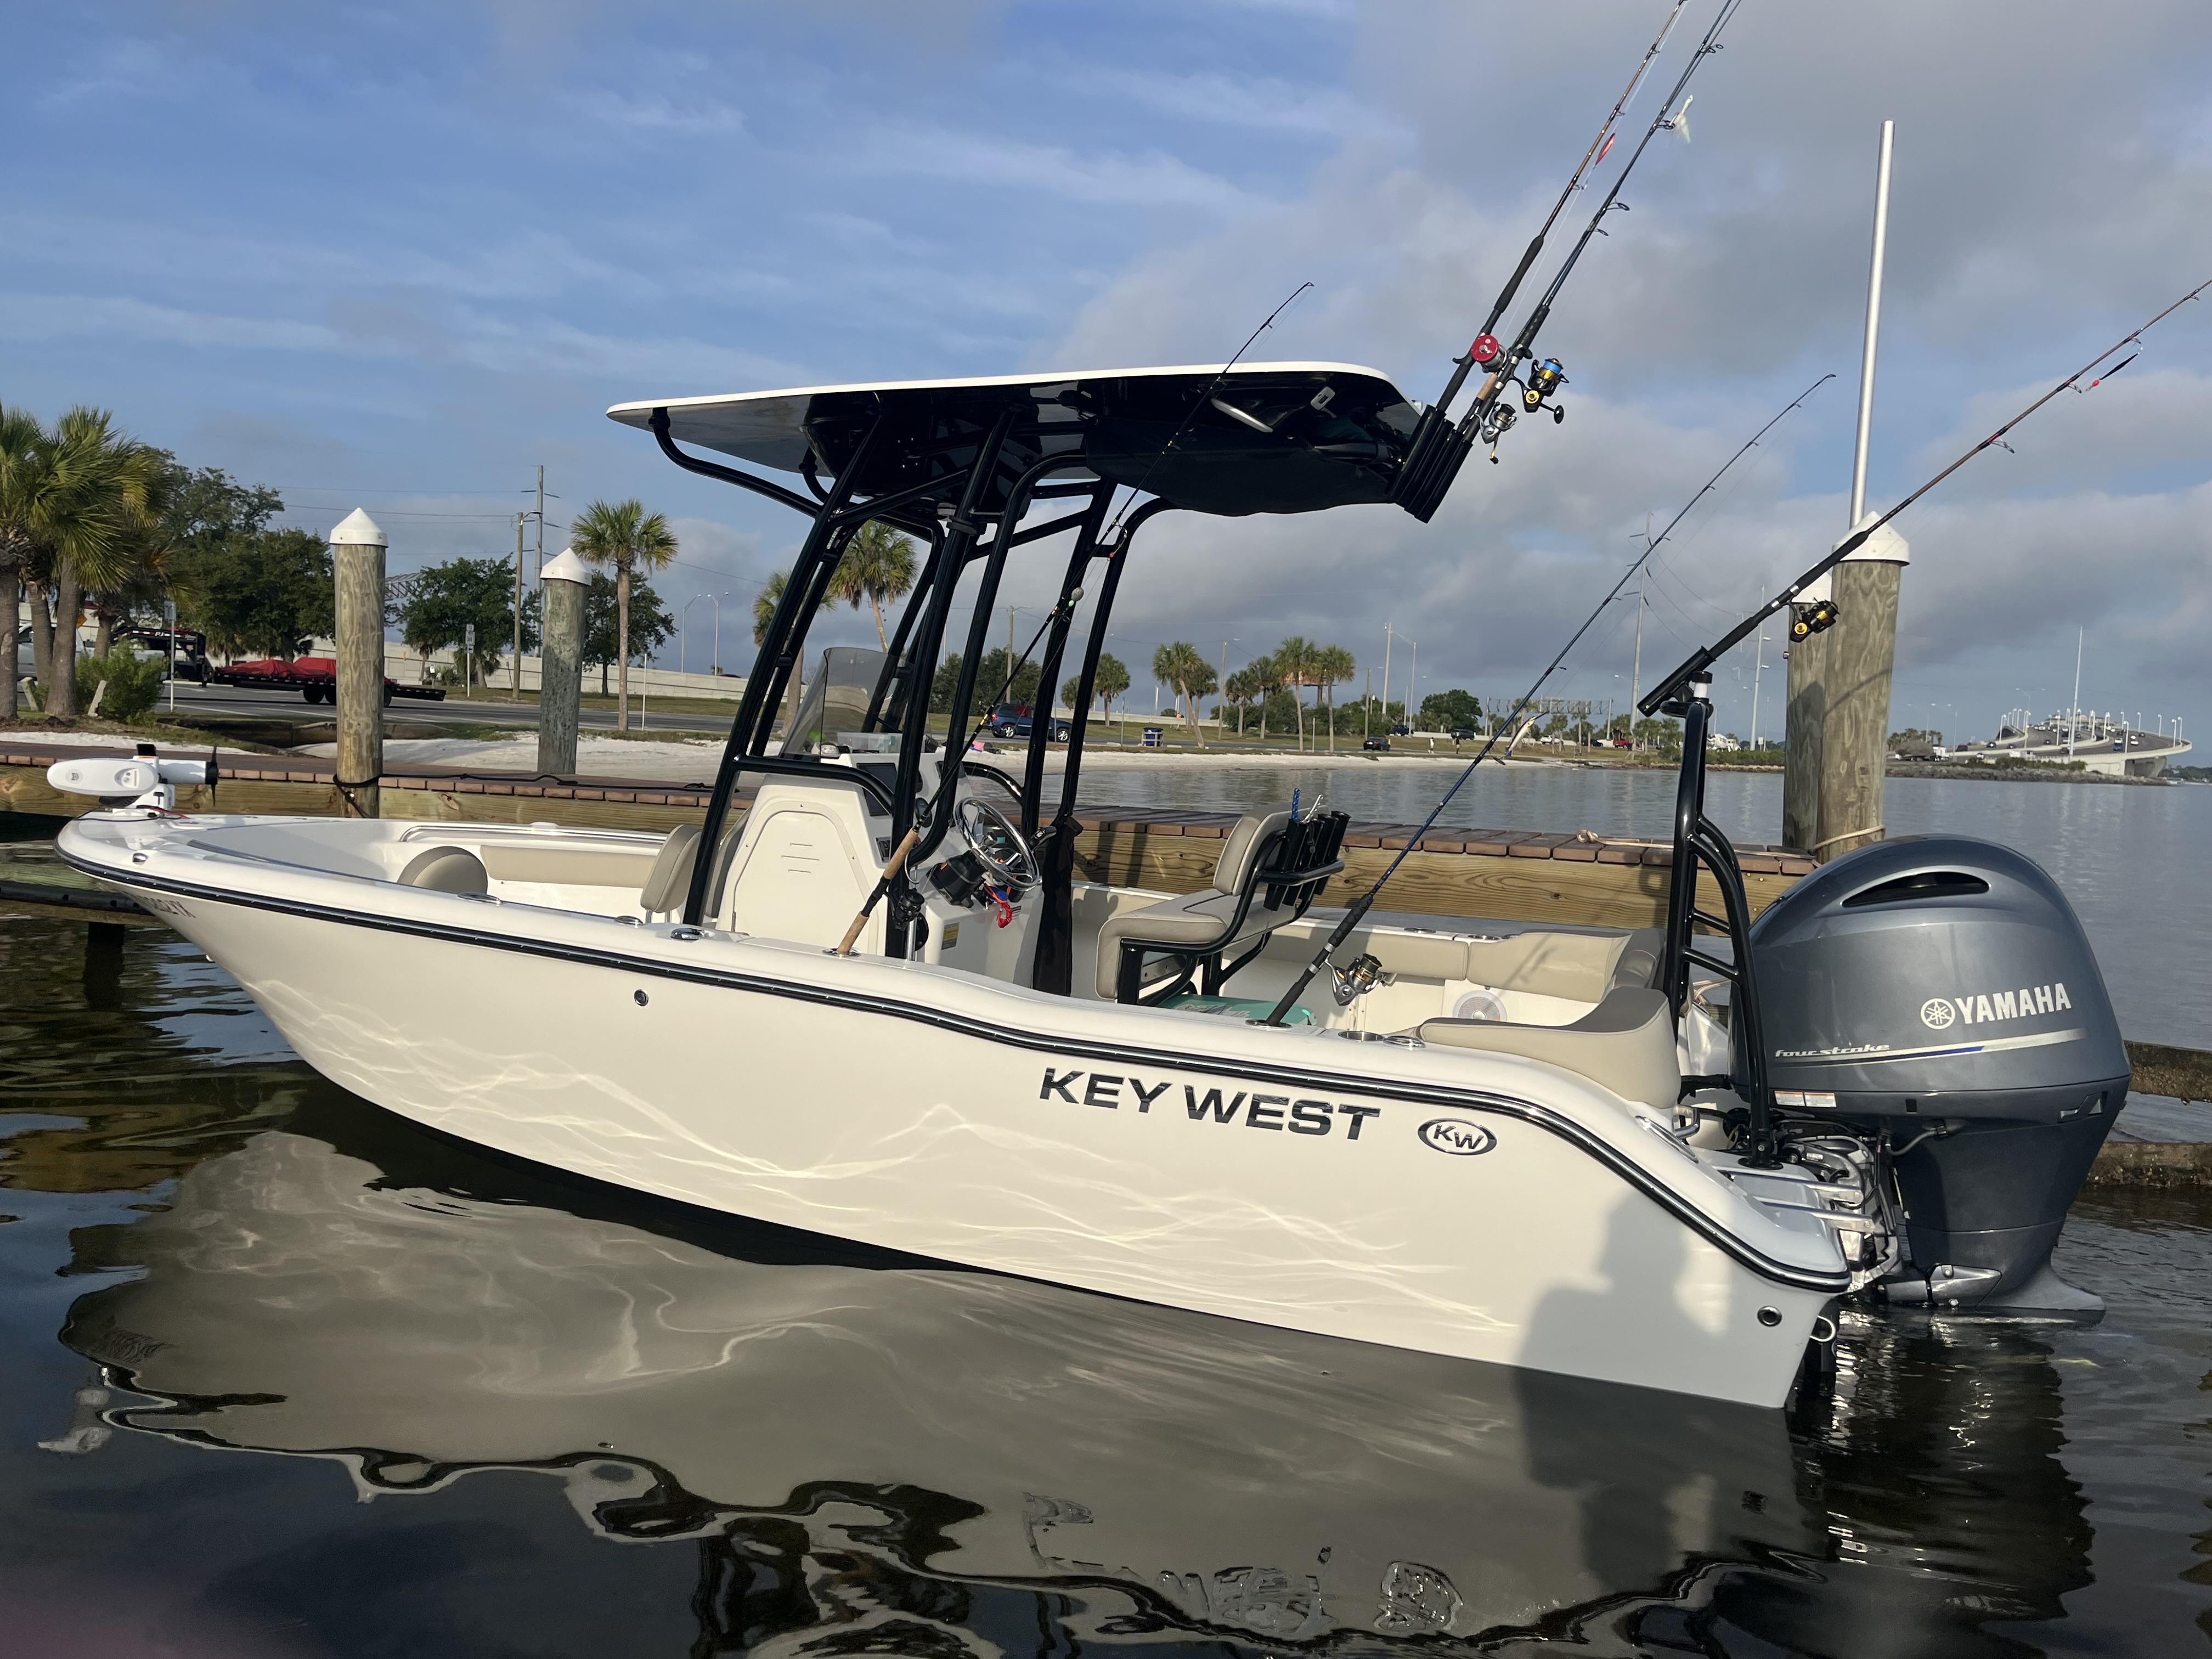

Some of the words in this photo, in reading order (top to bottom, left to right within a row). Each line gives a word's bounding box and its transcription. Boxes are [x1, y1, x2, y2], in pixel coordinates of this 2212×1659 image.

[1954, 982, 2072, 1025] YAMAHA
[1040, 1067, 1172, 1114] KEY
[1183, 1085, 1382, 1141] WEST
[1434, 1124, 1484, 1149] KW
